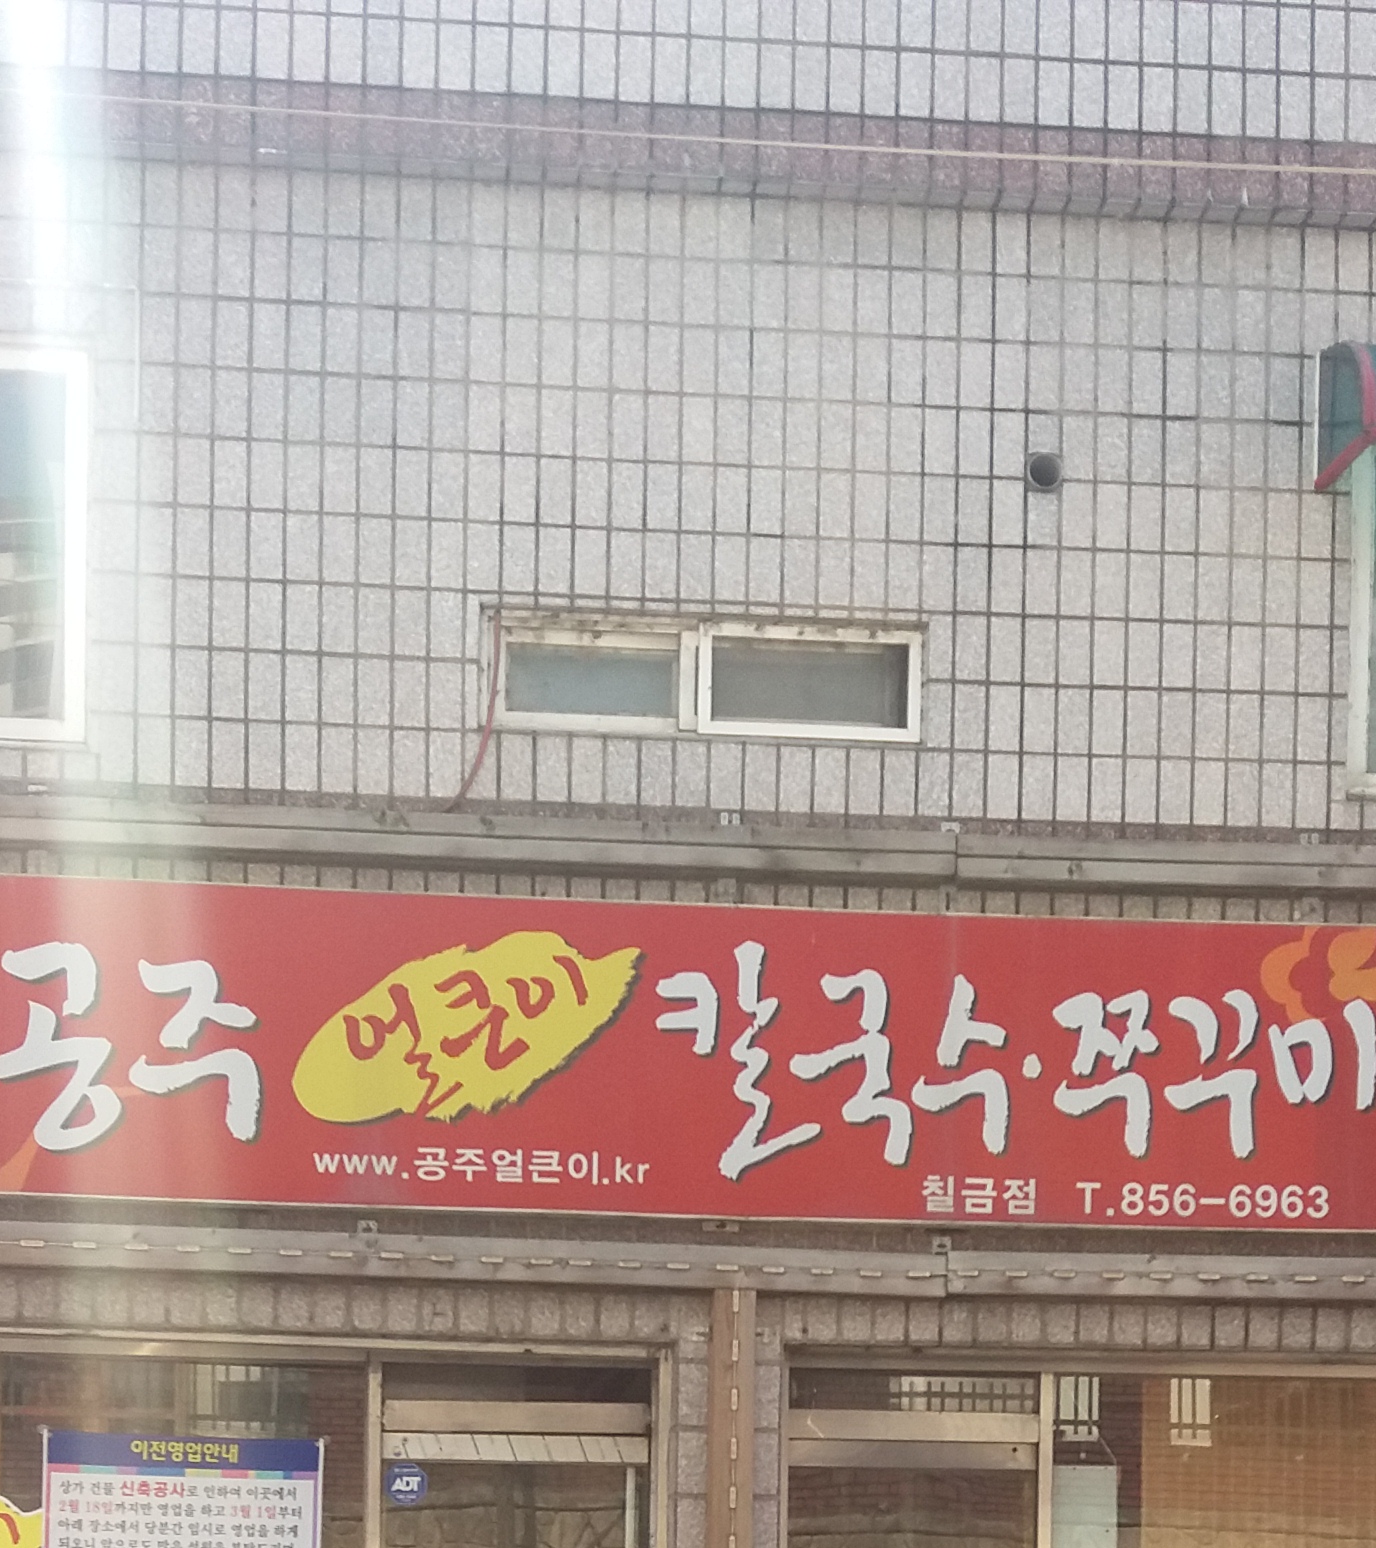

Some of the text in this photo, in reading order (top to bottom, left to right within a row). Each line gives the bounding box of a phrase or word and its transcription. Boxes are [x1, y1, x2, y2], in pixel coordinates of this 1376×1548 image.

[343, 955, 589, 1116] 얼큰이
[313, 1147, 650, 1185] www.공주얼큰이.kr
[921, 1175, 1330, 1219] 칠금점 T.856-6963
[130, 1440, 238, 1463] 이전영업안내
[59, 1480, 84, 1495] 상가
[246, 1486, 297, 1501] 이곳에서
[391, 1476, 422, 1491] ADT
[157, 1502, 196, 1517] 영업을
[201, 1504, 226, 1517] 하고
[58, 1518, 83, 1532] 아래
[231, 1523, 270, 1538] 영업을
